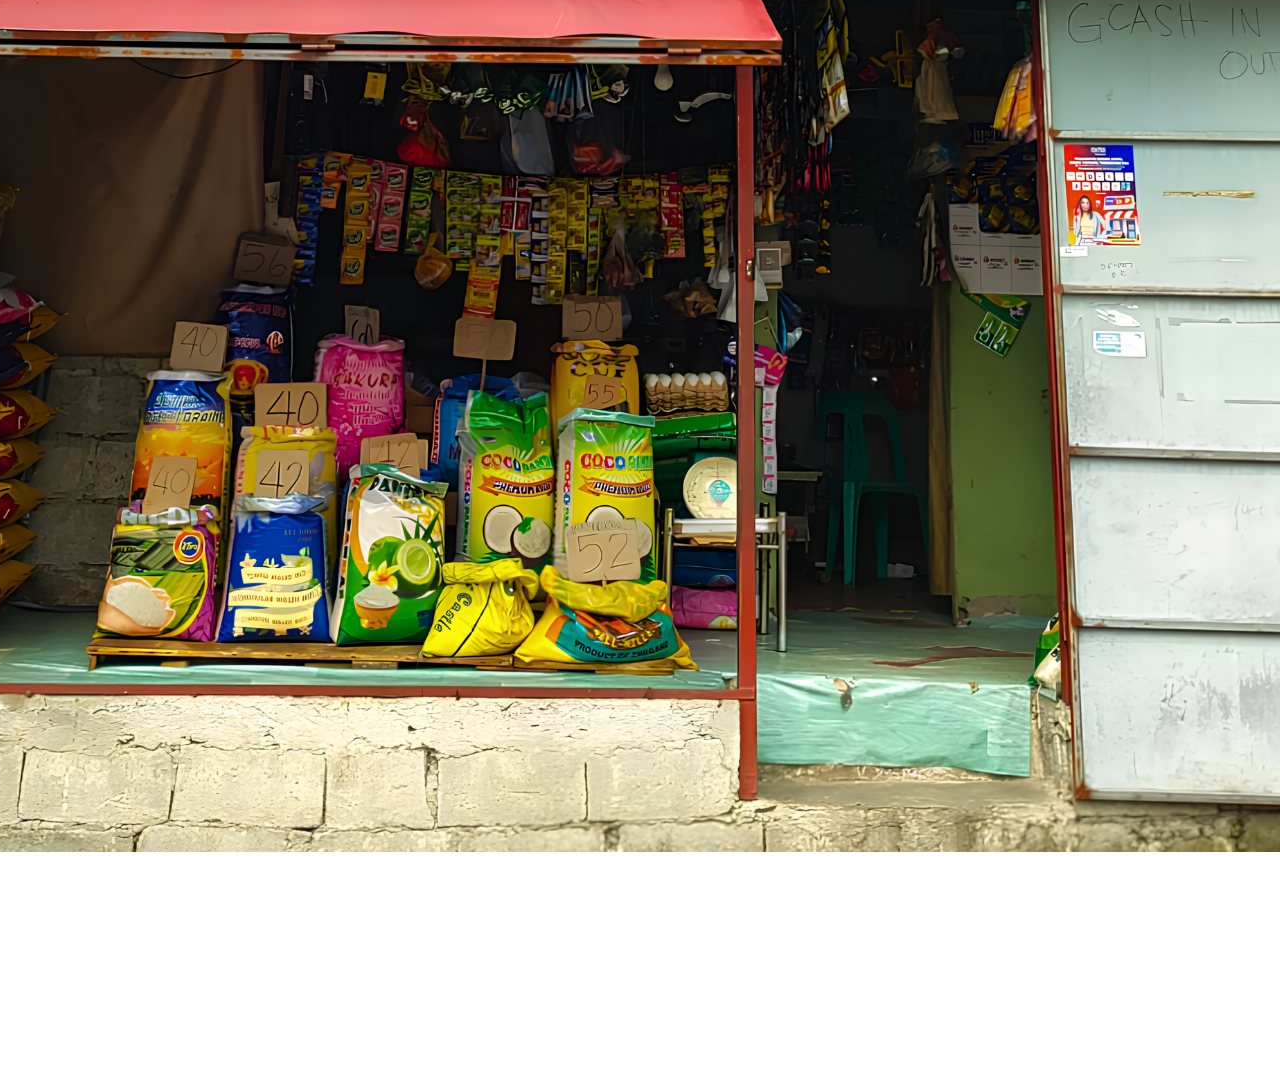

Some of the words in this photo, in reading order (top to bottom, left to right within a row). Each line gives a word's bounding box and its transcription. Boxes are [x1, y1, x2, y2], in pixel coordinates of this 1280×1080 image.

[1230, 6, 1262, 38] IN
[570, 300, 615, 334] 50
[181, 326, 218, 360] 40
[265, 390, 320, 426] 40
[586, 383, 617, 405] 55
[153, 464, 191, 496] 40
[577, 532, 634, 576] 52
